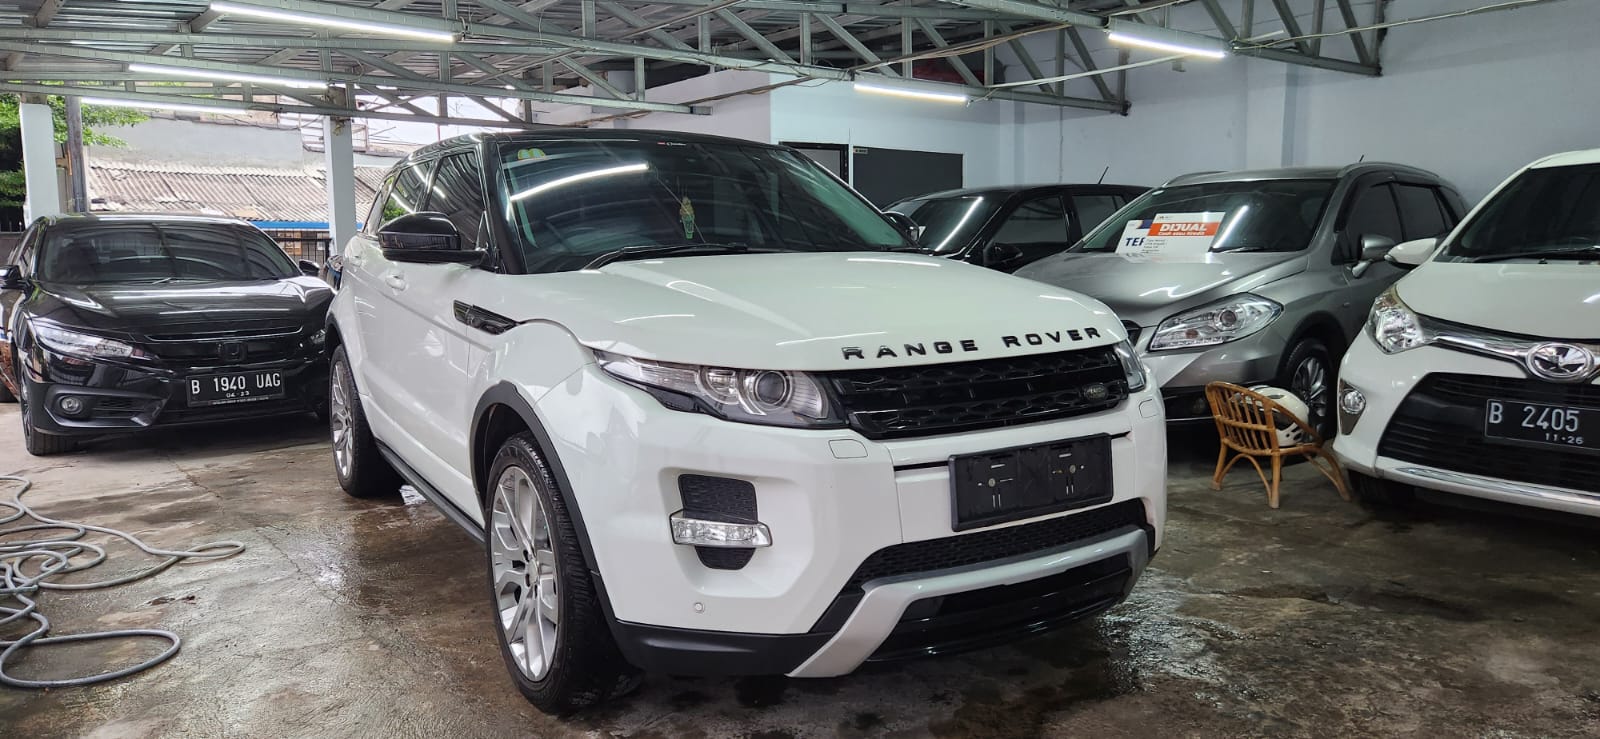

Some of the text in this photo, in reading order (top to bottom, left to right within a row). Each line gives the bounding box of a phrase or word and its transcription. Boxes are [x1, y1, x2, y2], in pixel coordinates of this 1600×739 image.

[1159, 223, 1207, 232] DIJUAL
[841, 327, 1101, 361] RANGE ROVER
[191, 372, 281, 395] B 1940 UAG
[1489, 402, 1580, 432] B 2405
